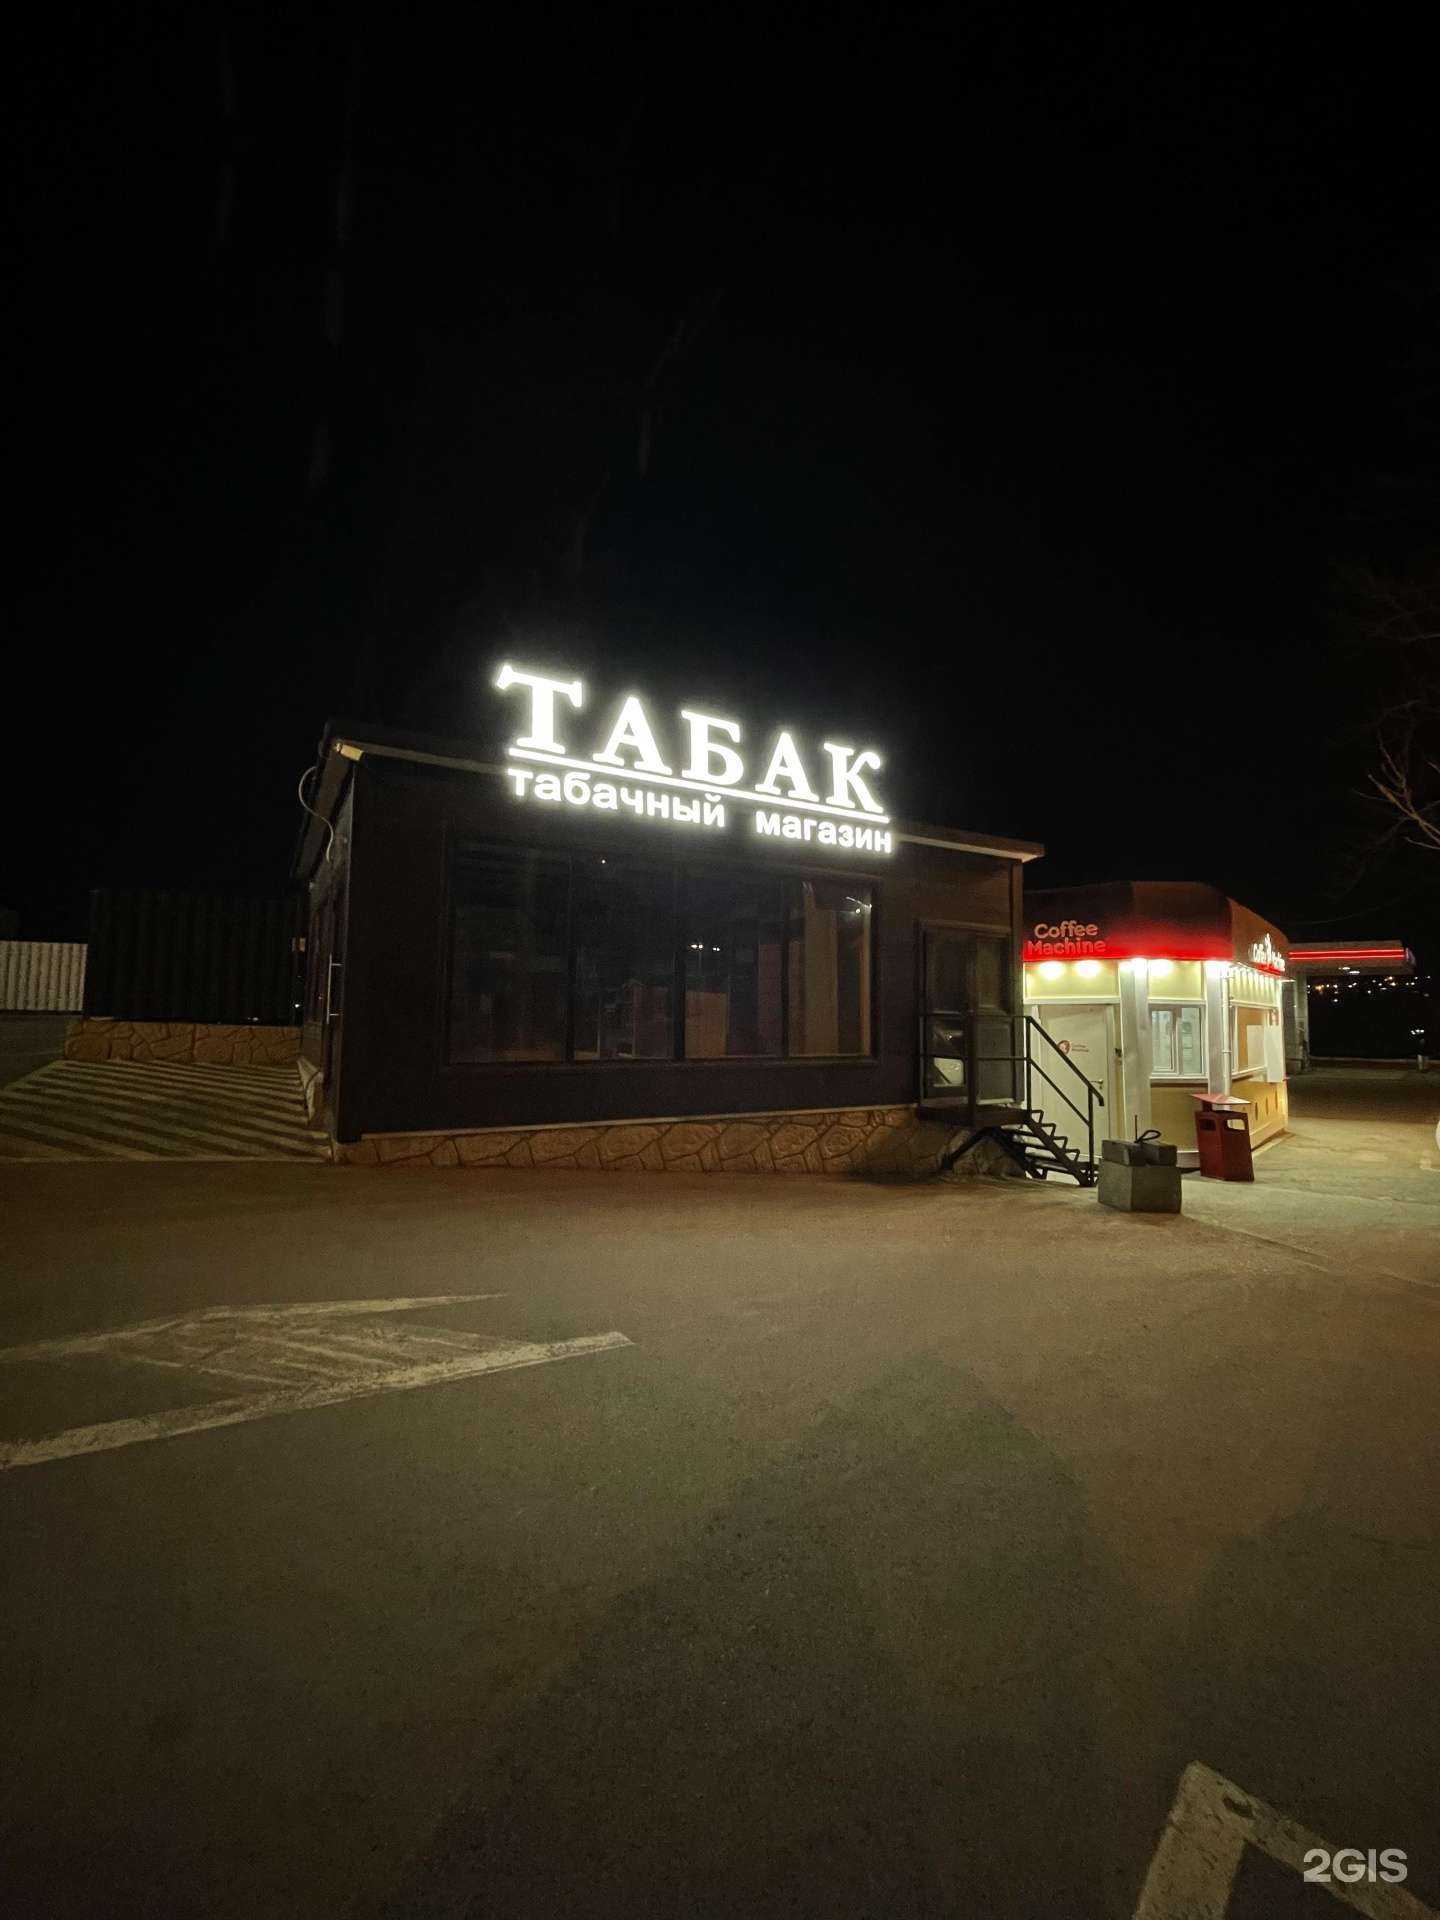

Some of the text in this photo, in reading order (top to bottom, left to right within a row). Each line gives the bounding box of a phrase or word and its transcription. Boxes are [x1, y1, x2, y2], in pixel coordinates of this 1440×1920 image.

[496, 664, 884, 814] ТАБАК
[507, 768, 893, 853] табачный магазин
[1027, 937, 1106, 955] Machine
[1034, 920, 1098, 939] Coffee
